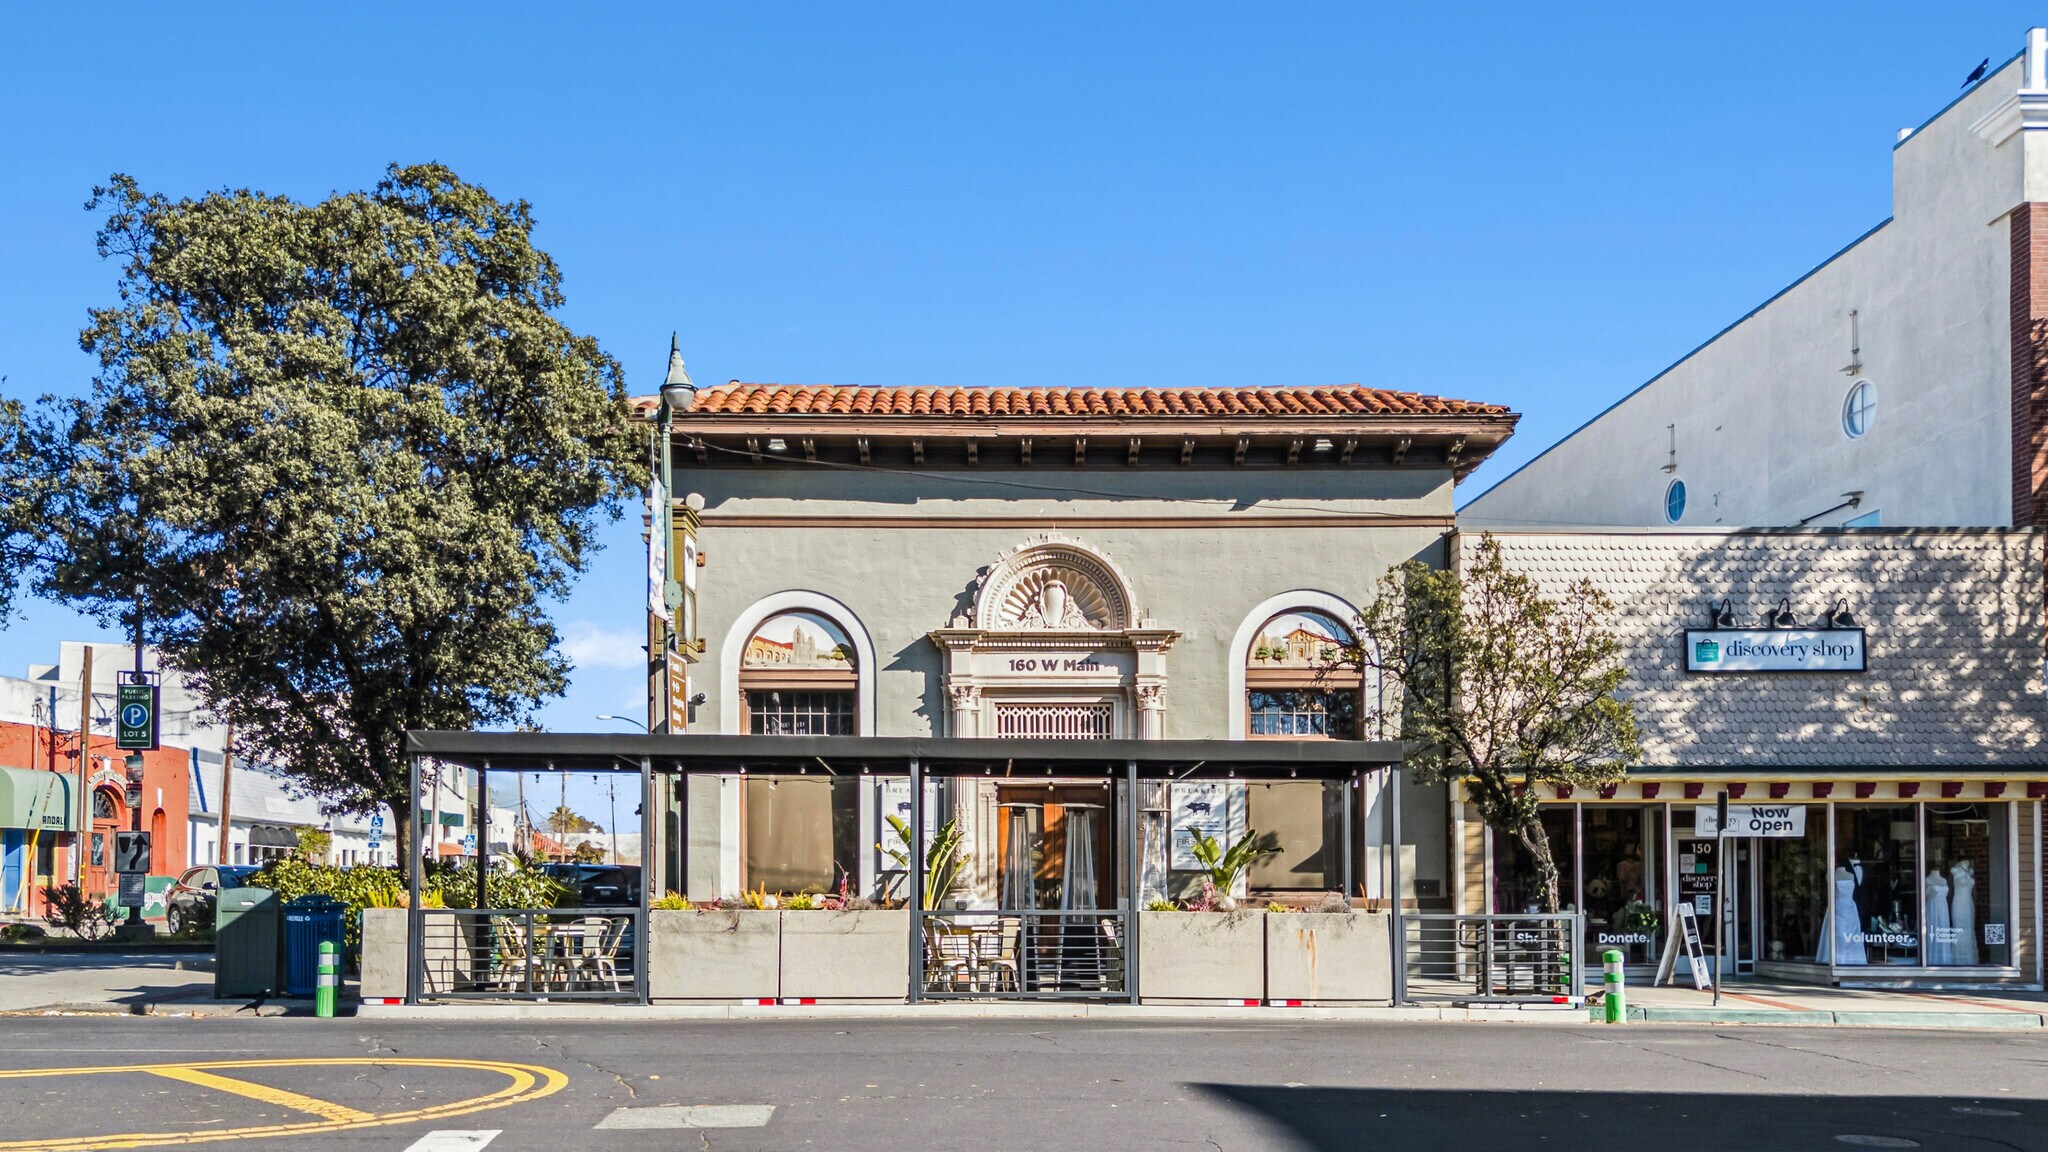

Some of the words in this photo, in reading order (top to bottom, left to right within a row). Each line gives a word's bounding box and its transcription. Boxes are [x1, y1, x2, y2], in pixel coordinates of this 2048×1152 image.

[1726, 640, 1809, 661] discovery
[1812, 639, 1854, 661] shop
[1009, 659, 1037, 671] 160
[1041, 659, 1059, 671] W
[1063, 659, 1100, 671] Main
[130, 707, 141, 725] P
[123, 730, 139, 738] LOT
[141, 730, 147, 738] 5
[1751, 807, 1790, 818] Now
[1749, 818, 1793, 835] Open
[1691, 843, 1712, 854] 150
[1692, 880, 1712, 890] shop
[1598, 932, 1650, 943] Donate.
[1842, 931, 1913, 943] Volunteer.
